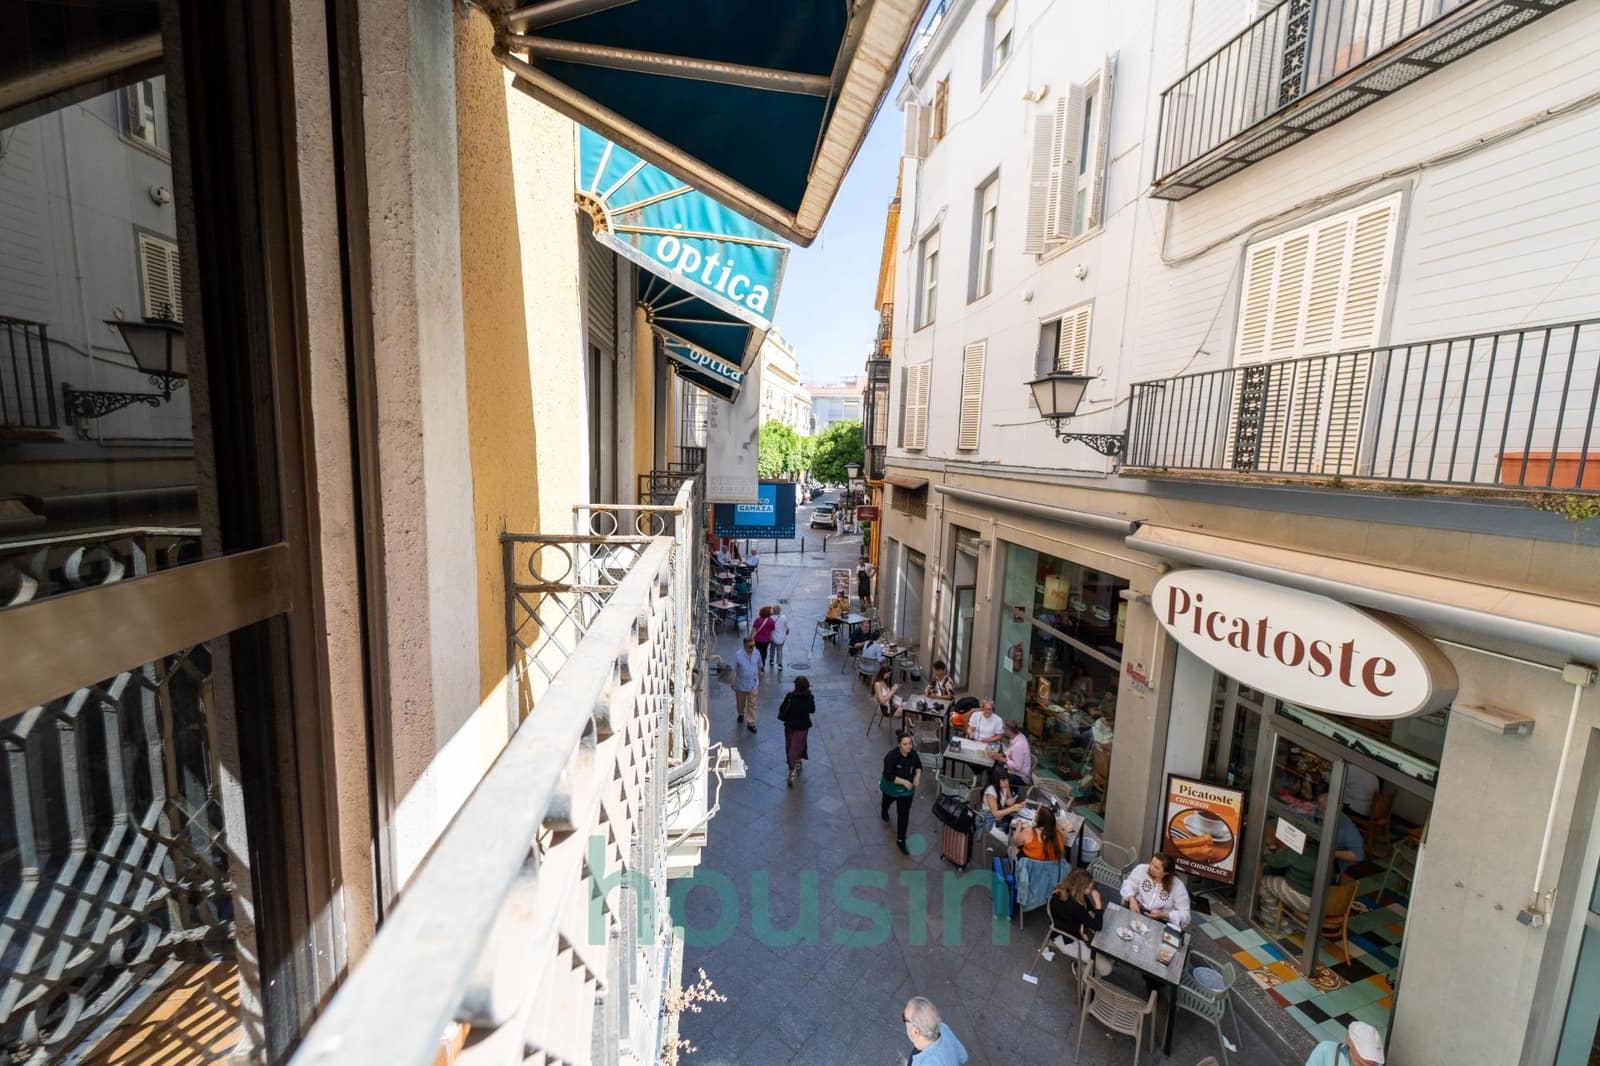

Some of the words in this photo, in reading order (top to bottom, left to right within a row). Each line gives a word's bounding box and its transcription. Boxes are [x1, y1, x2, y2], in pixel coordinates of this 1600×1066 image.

[1167, 586, 1396, 698] Picatoste
[1179, 784, 1233, 805] Picatoste
[1176, 858, 1190, 866] CON
[1190, 862, 1228, 876] CHOCOLATE
